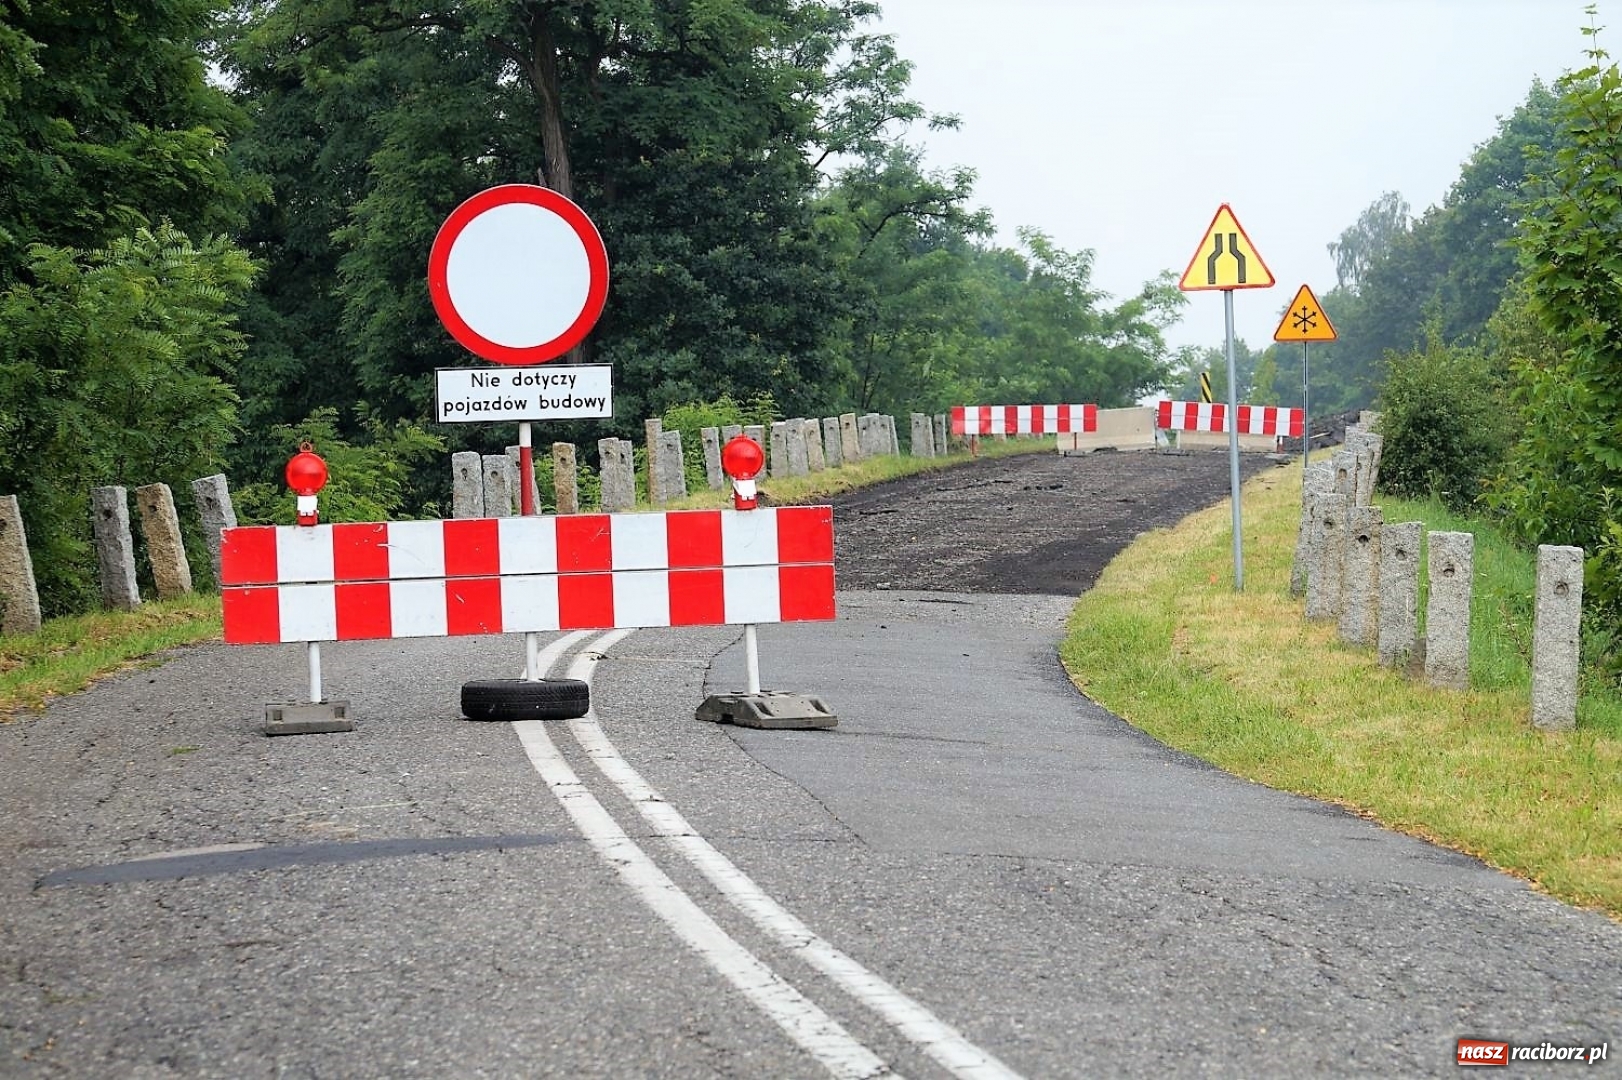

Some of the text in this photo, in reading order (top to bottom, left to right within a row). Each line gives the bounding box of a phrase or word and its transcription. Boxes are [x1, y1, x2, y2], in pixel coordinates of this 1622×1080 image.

[471, 372, 577, 390] Nie dotyczy
[443, 394, 606, 416] pojazdów budowy
